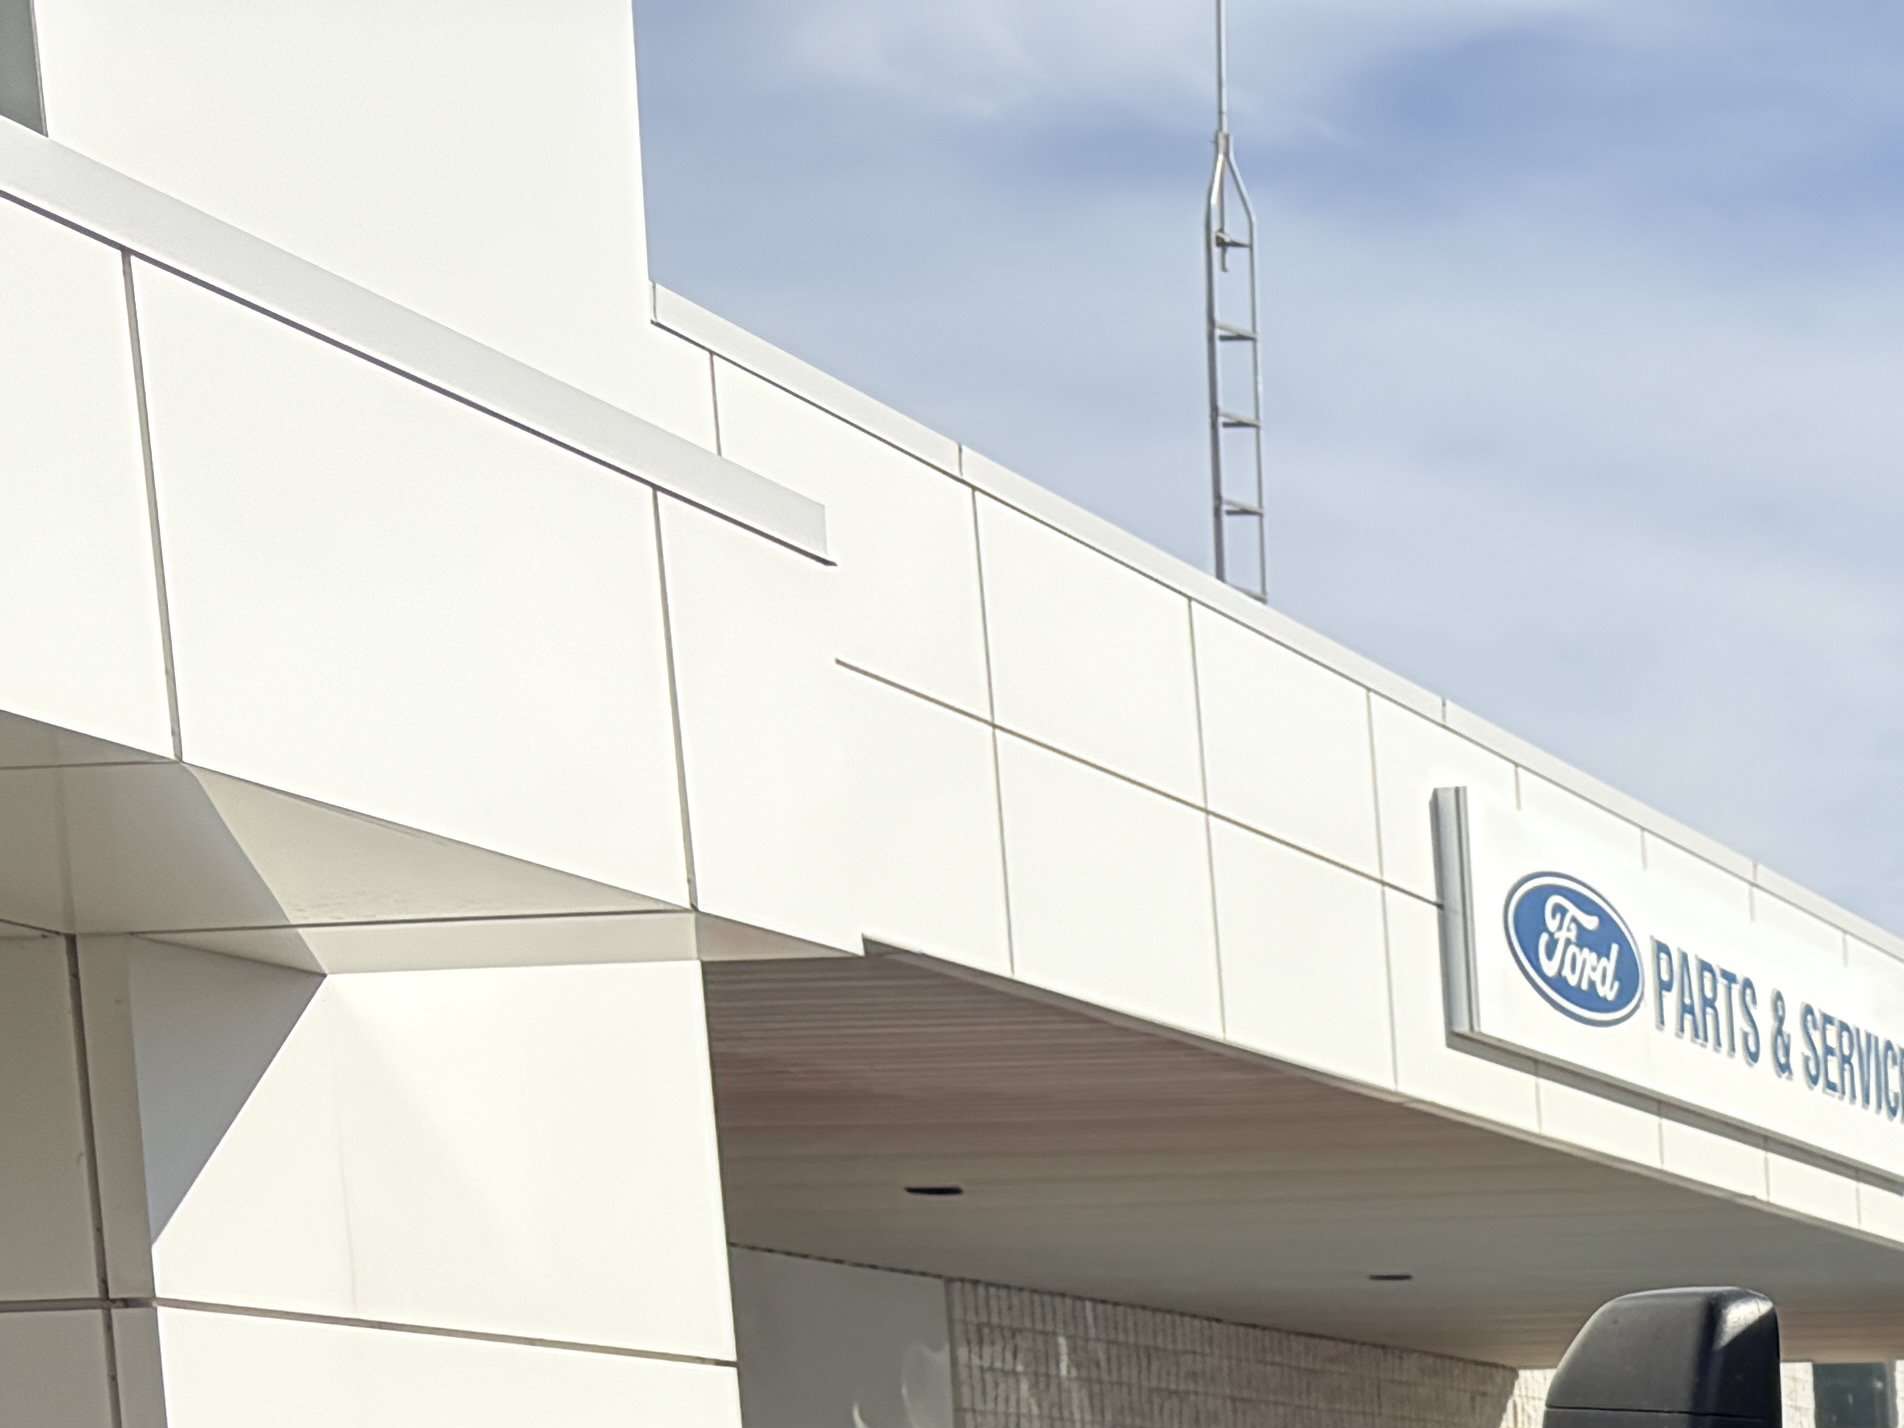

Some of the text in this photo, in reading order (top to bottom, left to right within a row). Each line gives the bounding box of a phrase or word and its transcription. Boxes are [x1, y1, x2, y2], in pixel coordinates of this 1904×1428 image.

[1538, 894, 1620, 1001] Ford
[1651, 935, 1760, 1066] PARTS
[1770, 987, 1793, 1078] &
